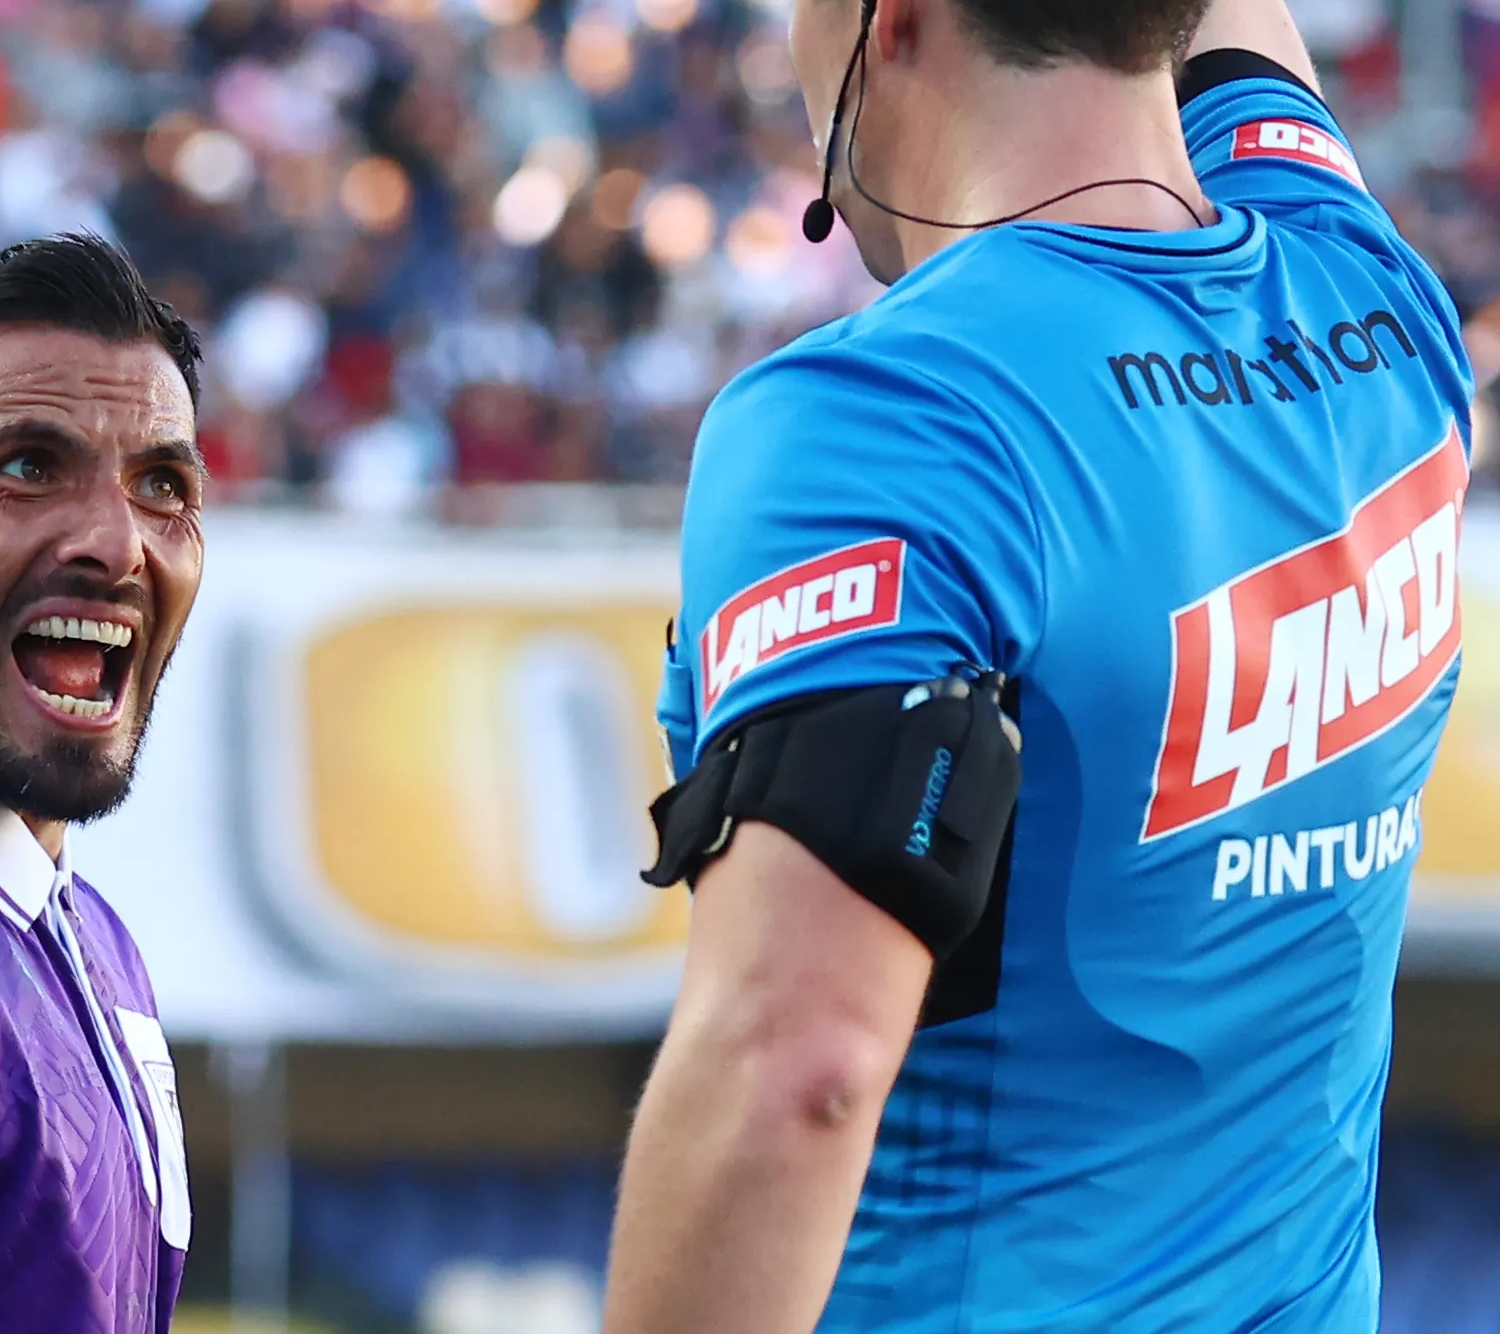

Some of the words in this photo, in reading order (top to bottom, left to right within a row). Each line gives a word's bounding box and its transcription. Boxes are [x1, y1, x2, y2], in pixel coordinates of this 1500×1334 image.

[706, 563, 877, 703] LANCO
[1192, 500, 1458, 805] LANCO
[1212, 791, 1424, 901] PINTURA
